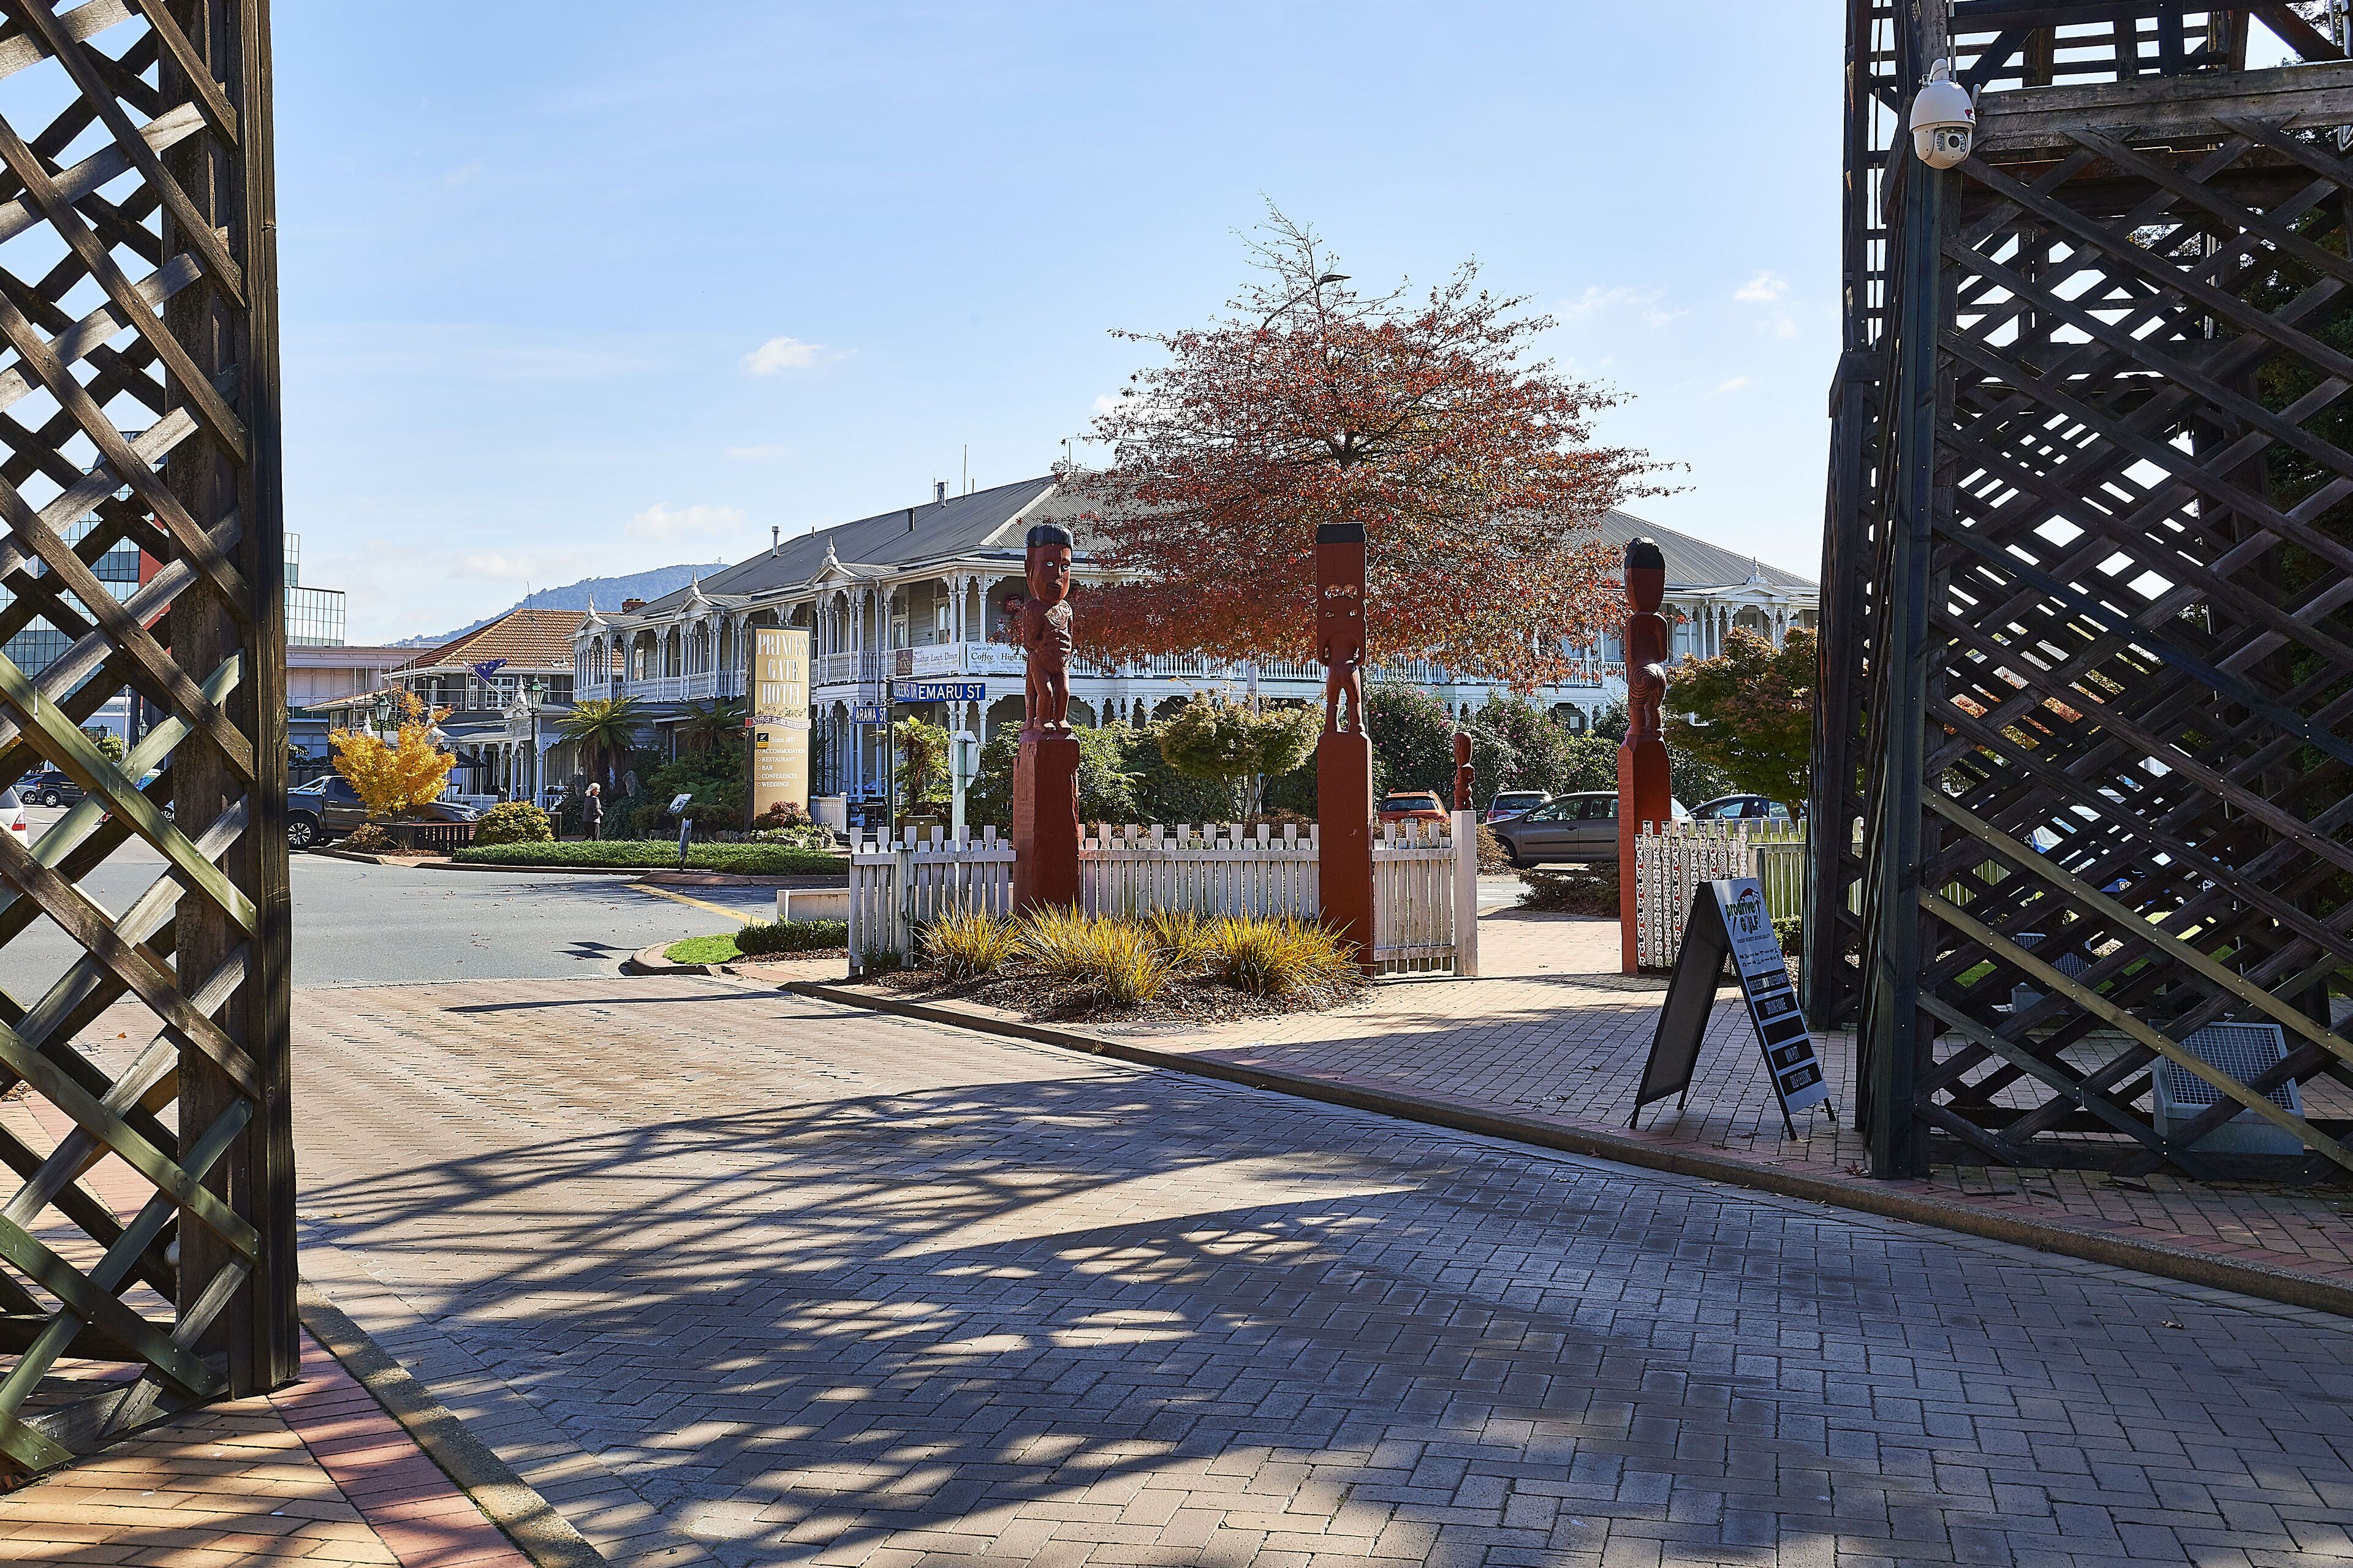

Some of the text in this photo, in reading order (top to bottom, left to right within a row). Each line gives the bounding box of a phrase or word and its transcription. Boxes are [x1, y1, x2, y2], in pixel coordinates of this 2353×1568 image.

[757, 634, 808, 657] PRINCES
[913, 654, 929, 664] Breakfast
[931, 653, 943, 661] Lunch
[971, 652, 994, 661] Coffee
[1001, 653, 1017, 661] High
[768, 659, 800, 681] GATE
[762, 683, 803, 705] HOTEL
[893, 683, 917, 699] QUEENS DR
[967, 684, 982, 699] ST
[855, 708, 887, 722] ARAWA ST
[771, 717, 787, 726] HISTORIC
[787, 719, 801, 729] BOUTIQUE
[1725, 898, 1756, 921] prodrive
[1740, 915, 1759, 934] GOLF
[1790, 1069, 1812, 1088] GOLF LESSONS
